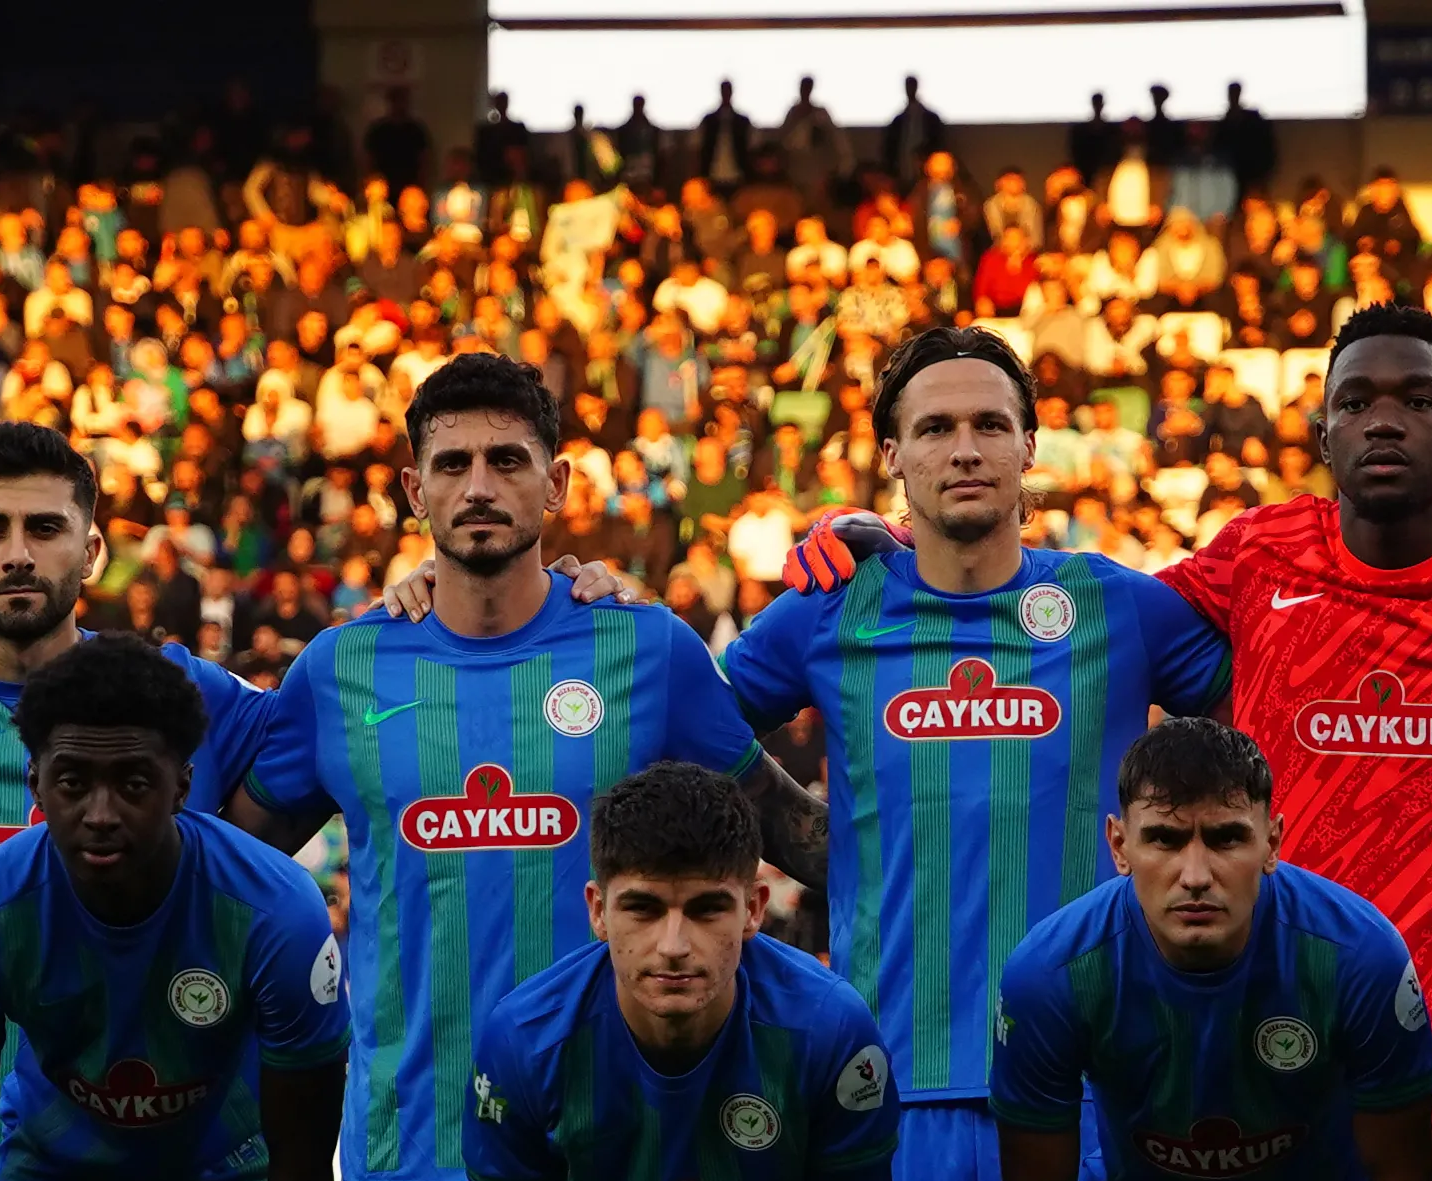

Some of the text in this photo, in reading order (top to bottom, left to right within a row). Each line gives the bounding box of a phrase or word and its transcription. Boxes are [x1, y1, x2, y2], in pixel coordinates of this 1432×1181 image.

[899, 699, 1044, 734] ÇAYKUR
[417, 808, 562, 845] ÇAYKUR
[70, 1078, 207, 1118] ÇAYKUR
[1146, 1134, 1293, 1170] ÇAYKUR
